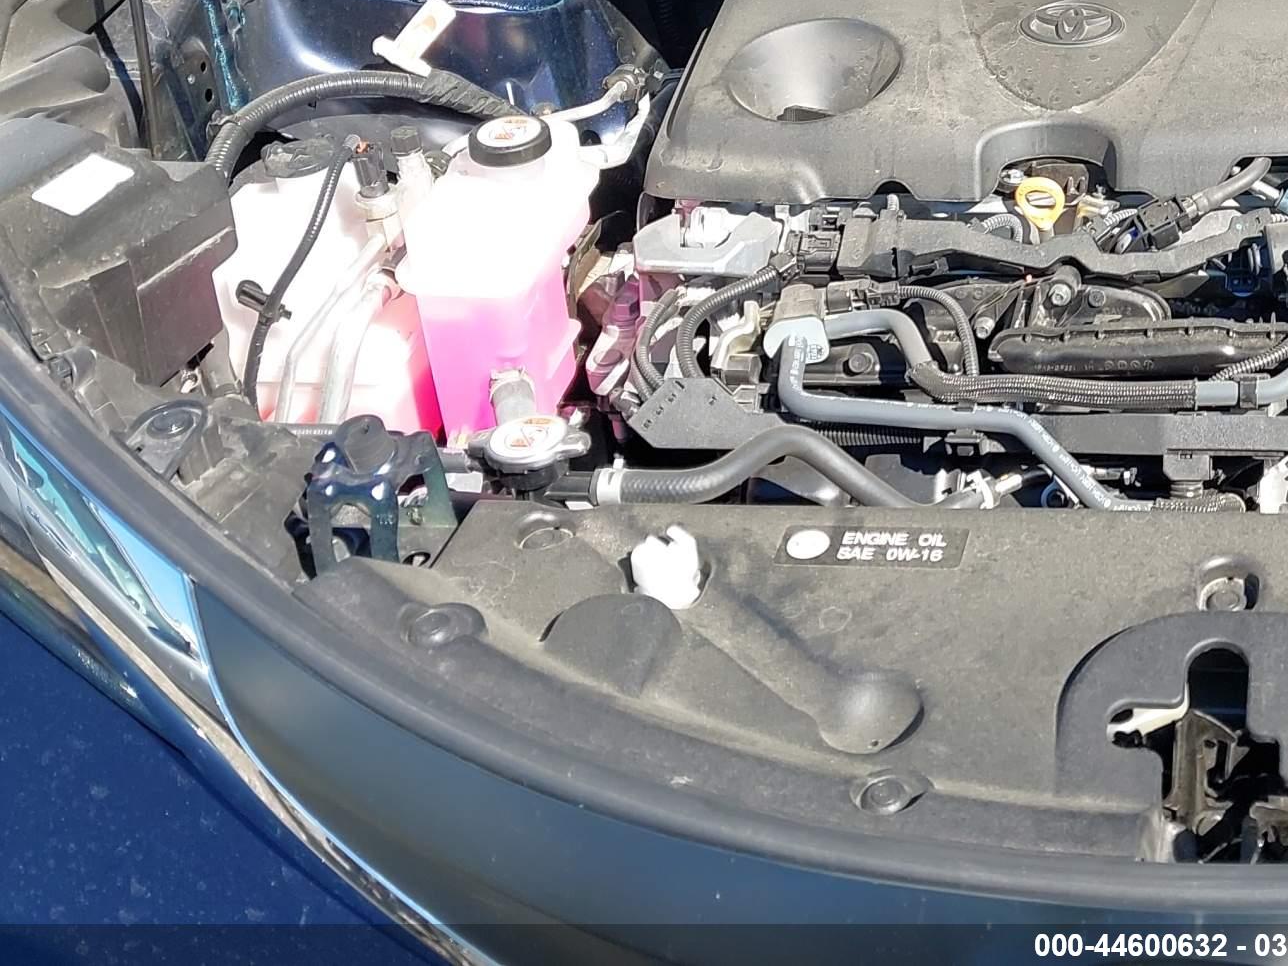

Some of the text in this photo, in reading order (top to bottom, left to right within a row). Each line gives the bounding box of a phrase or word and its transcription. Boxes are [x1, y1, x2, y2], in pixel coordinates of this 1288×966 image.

[841, 531, 948, 547] ENGINE OIL
[836, 546, 944, 562] SAE 0W-16
